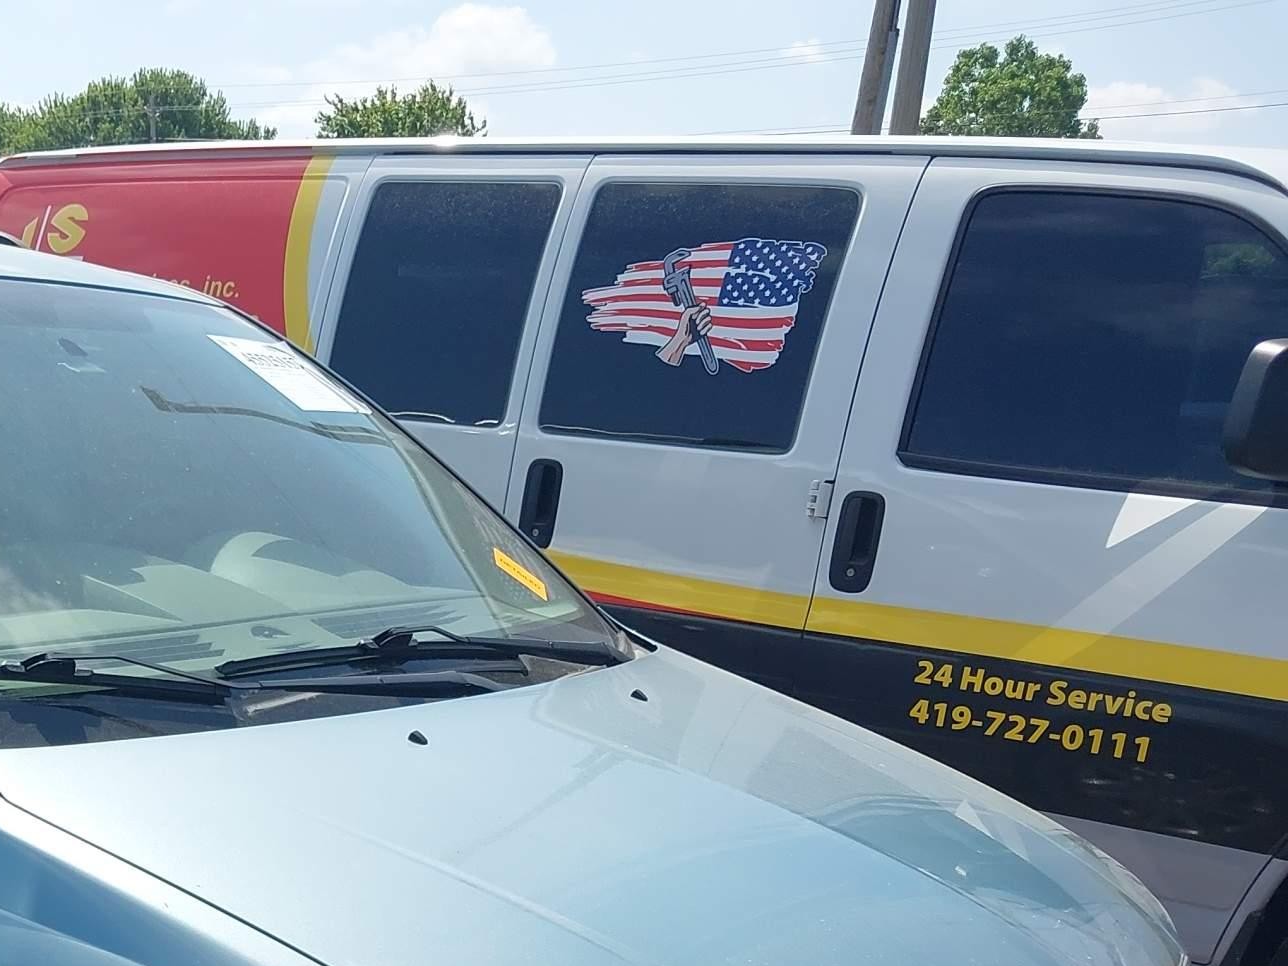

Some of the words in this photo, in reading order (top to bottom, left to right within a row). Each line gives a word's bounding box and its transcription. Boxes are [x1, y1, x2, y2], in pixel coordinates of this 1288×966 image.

[914, 660, 953, 688] 24
[959, 666, 1041, 701] Hour
[1046, 680, 1172, 723] Service
[909, 699, 1150, 762] 419-727-0111
